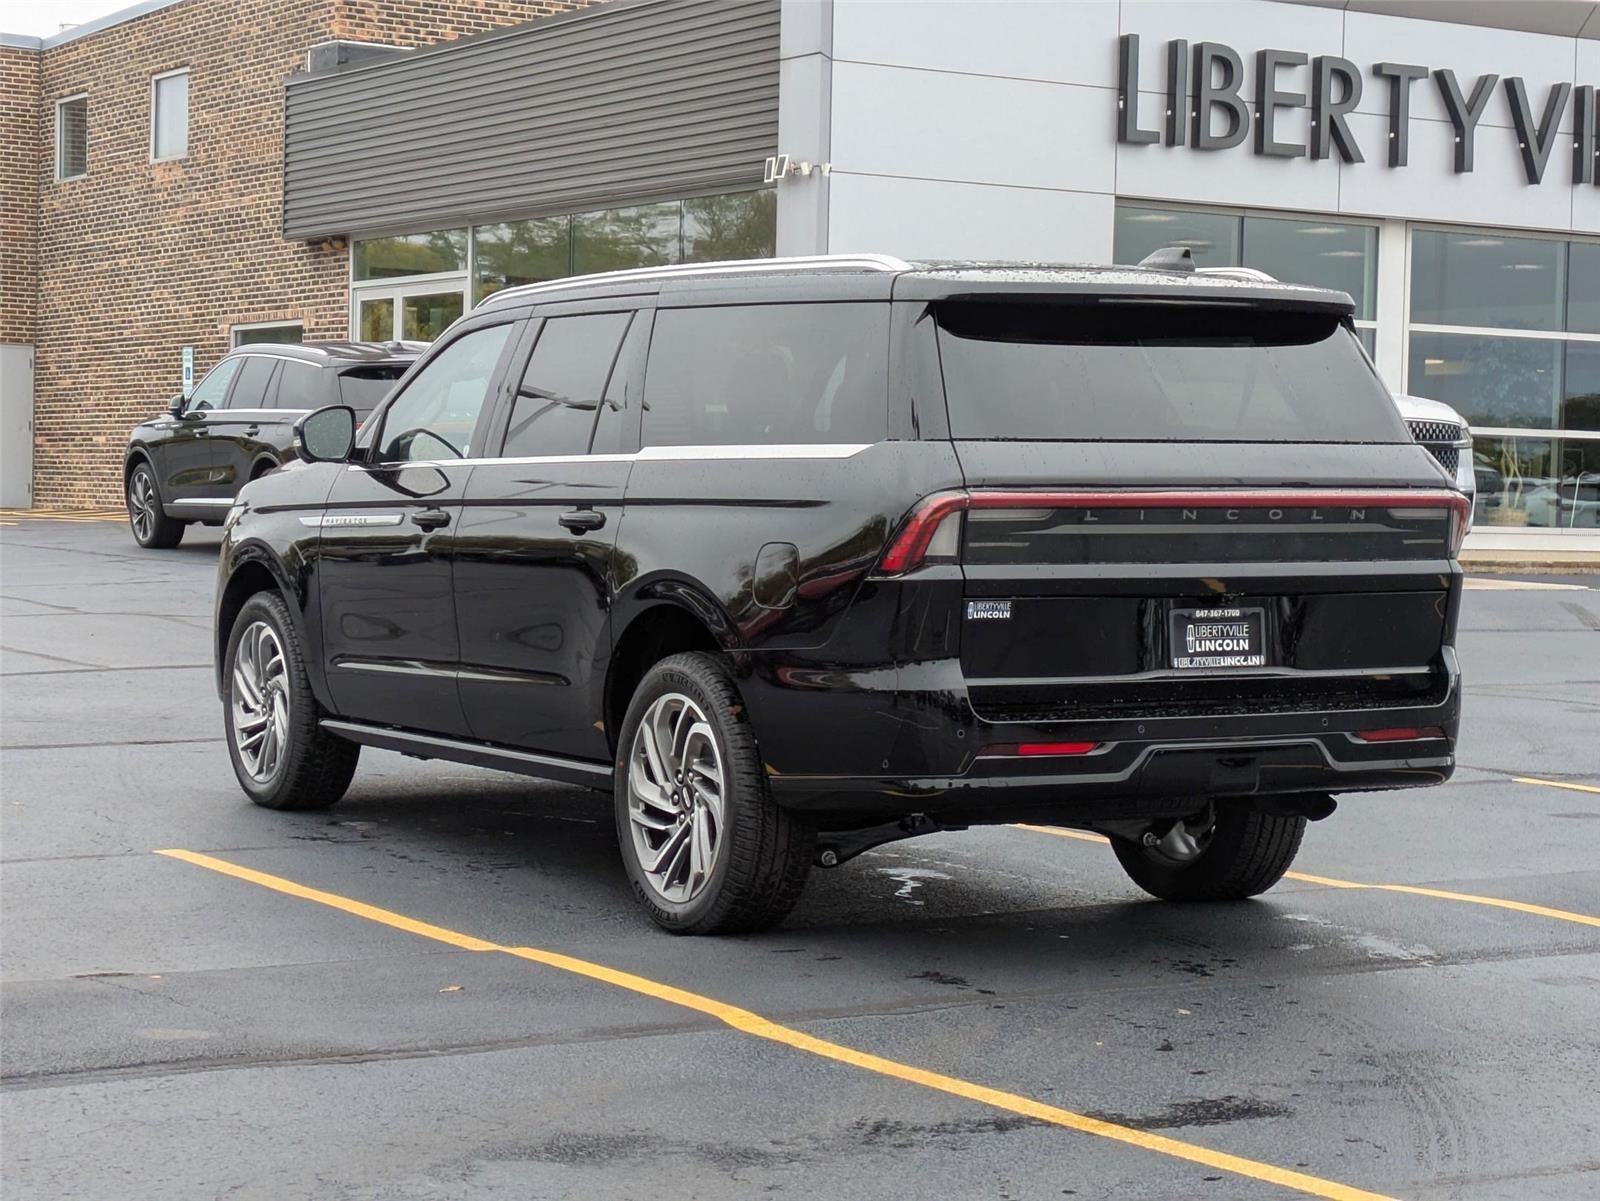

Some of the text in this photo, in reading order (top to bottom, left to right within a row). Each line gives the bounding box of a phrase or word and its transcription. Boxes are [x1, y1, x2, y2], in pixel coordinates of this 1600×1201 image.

[1117, 33, 1600, 186] LIBERTYVI
[1084, 509, 1366, 521] LINCOLN
[973, 610, 1010, 619] LINCOLN
[1195, 624, 1249, 637] LIBERTYVILLE
[1195, 639, 1249, 652] LINCOLN
